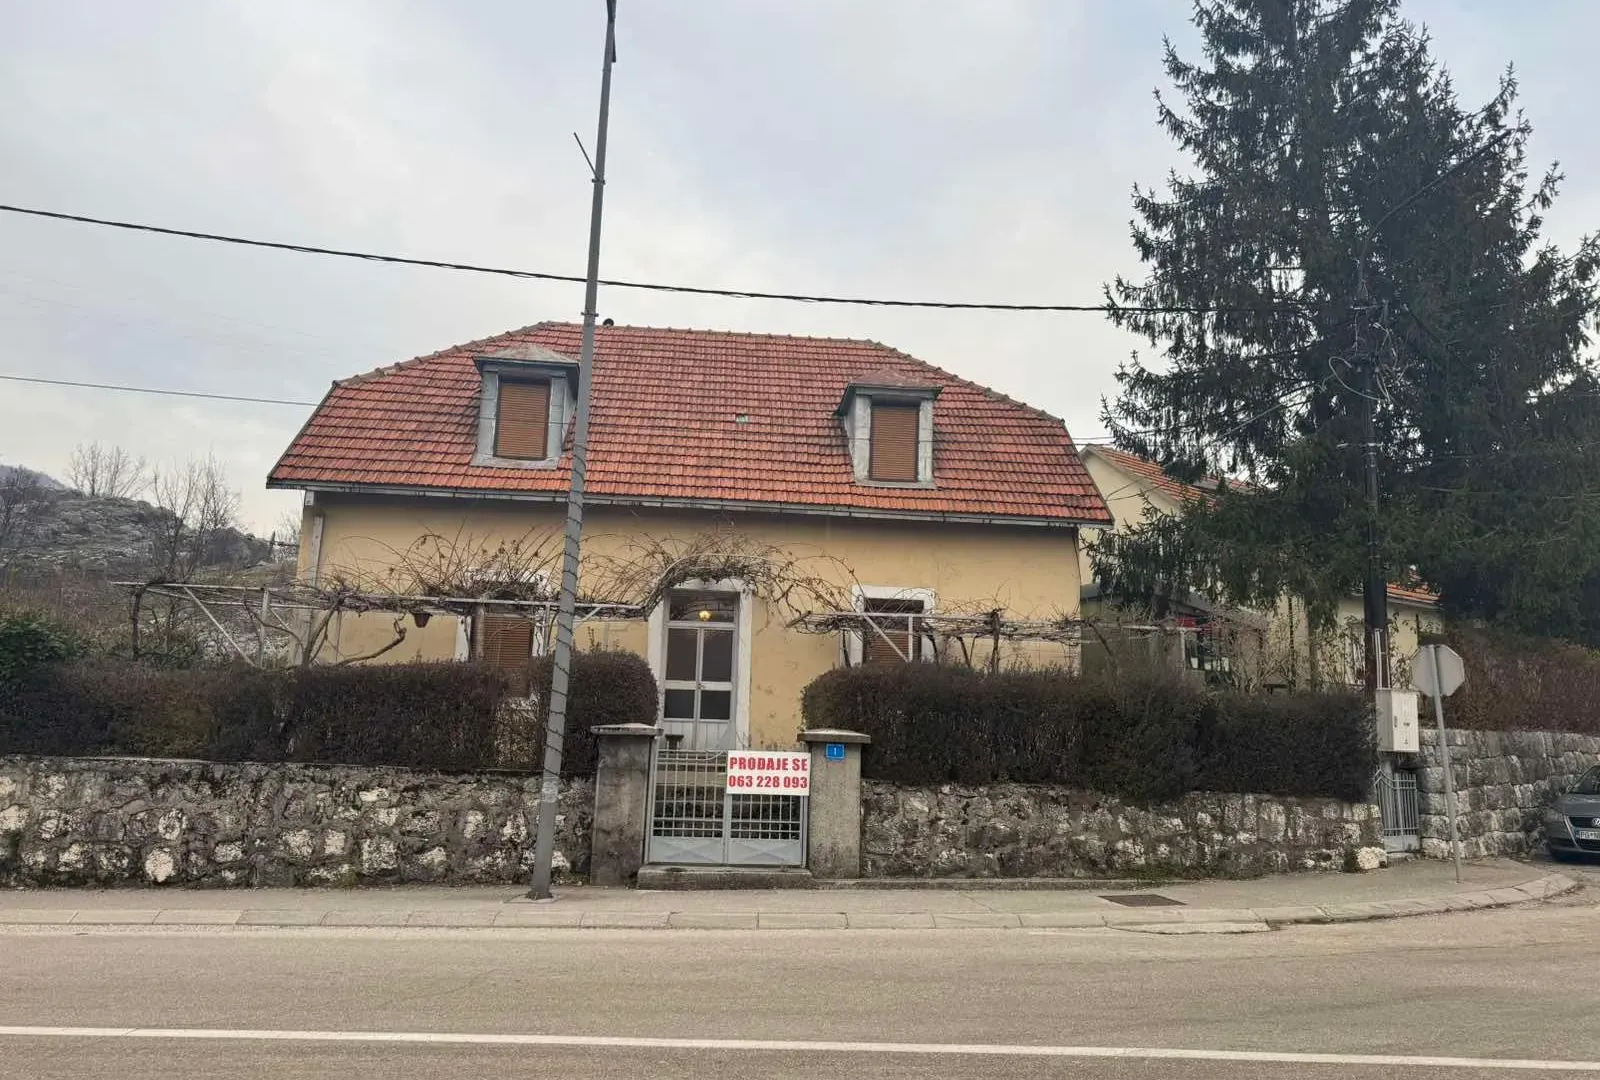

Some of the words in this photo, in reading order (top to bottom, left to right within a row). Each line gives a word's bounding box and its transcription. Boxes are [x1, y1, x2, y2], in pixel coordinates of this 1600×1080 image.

[729, 757, 788, 771] PRODAJE
[792, 758, 808, 771] SE
[728, 775, 753, 788] 063
[756, 776, 780, 788] 228
[783, 776, 808, 789] 093
